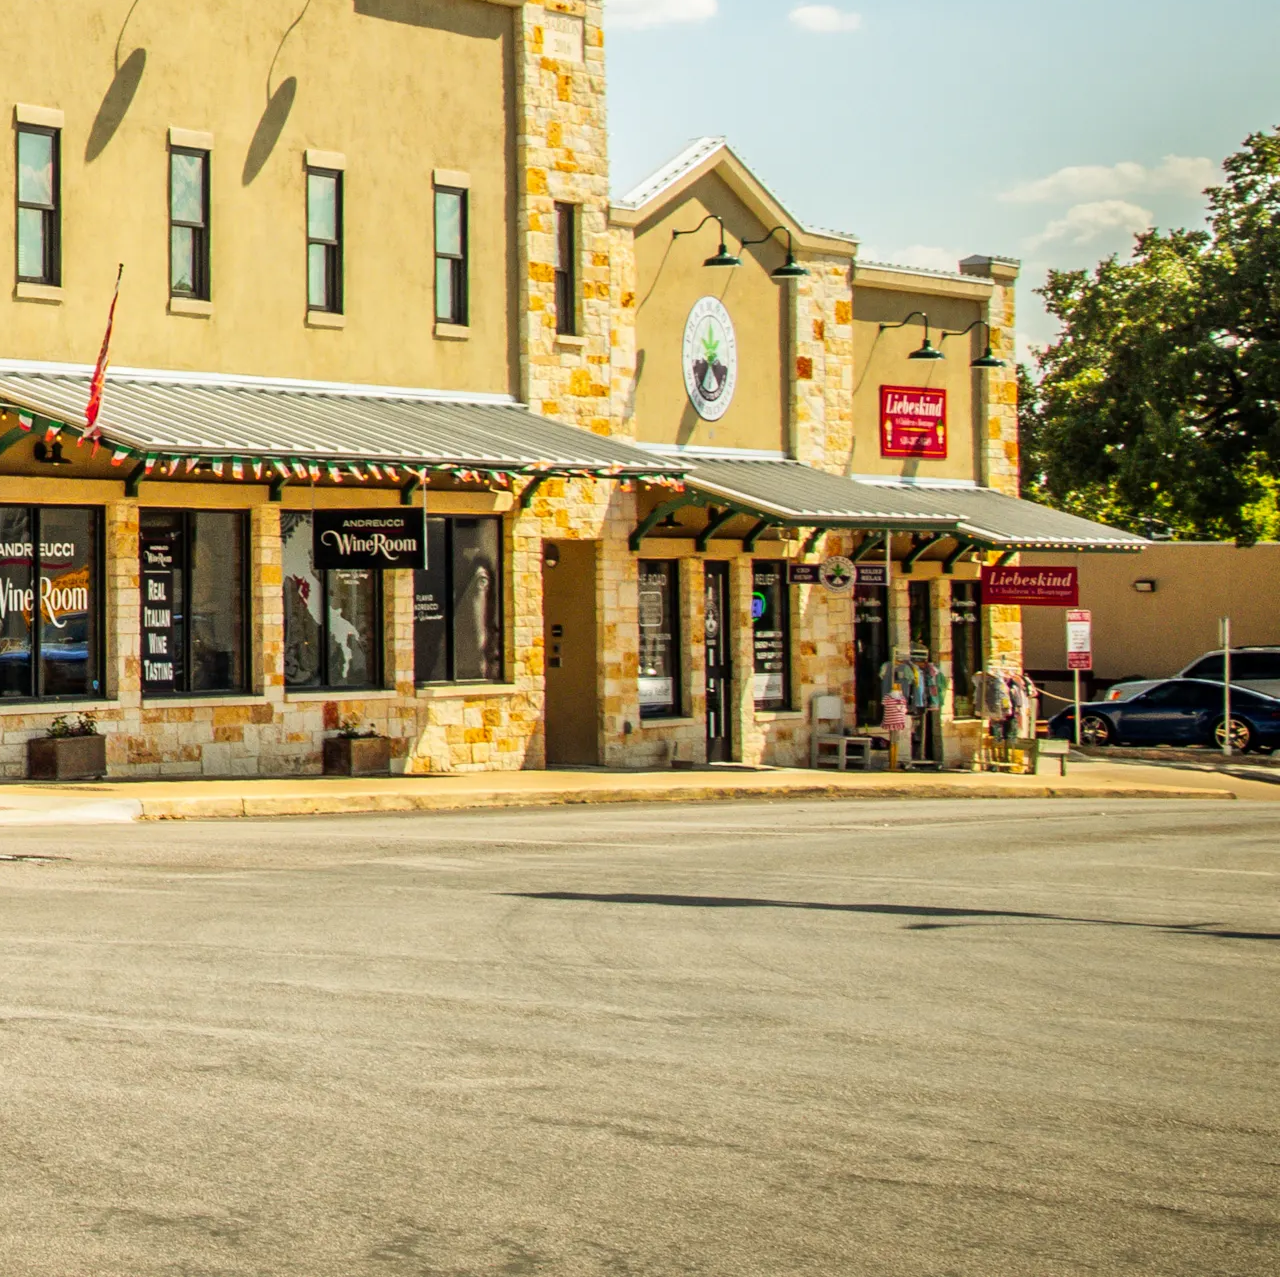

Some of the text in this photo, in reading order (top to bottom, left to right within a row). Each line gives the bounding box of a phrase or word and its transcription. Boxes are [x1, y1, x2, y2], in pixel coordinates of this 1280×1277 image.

[886, 393, 943, 417] Liebeskind
[343, 519, 404, 527] ANDREUCCI
[148, 579, 167, 601] REAL
[989, 572, 1072, 587] Liebeskind
[144, 606, 171, 627] ITALIAN
[148, 633, 167, 654] WINE
[144, 660, 173, 680] TASTING
